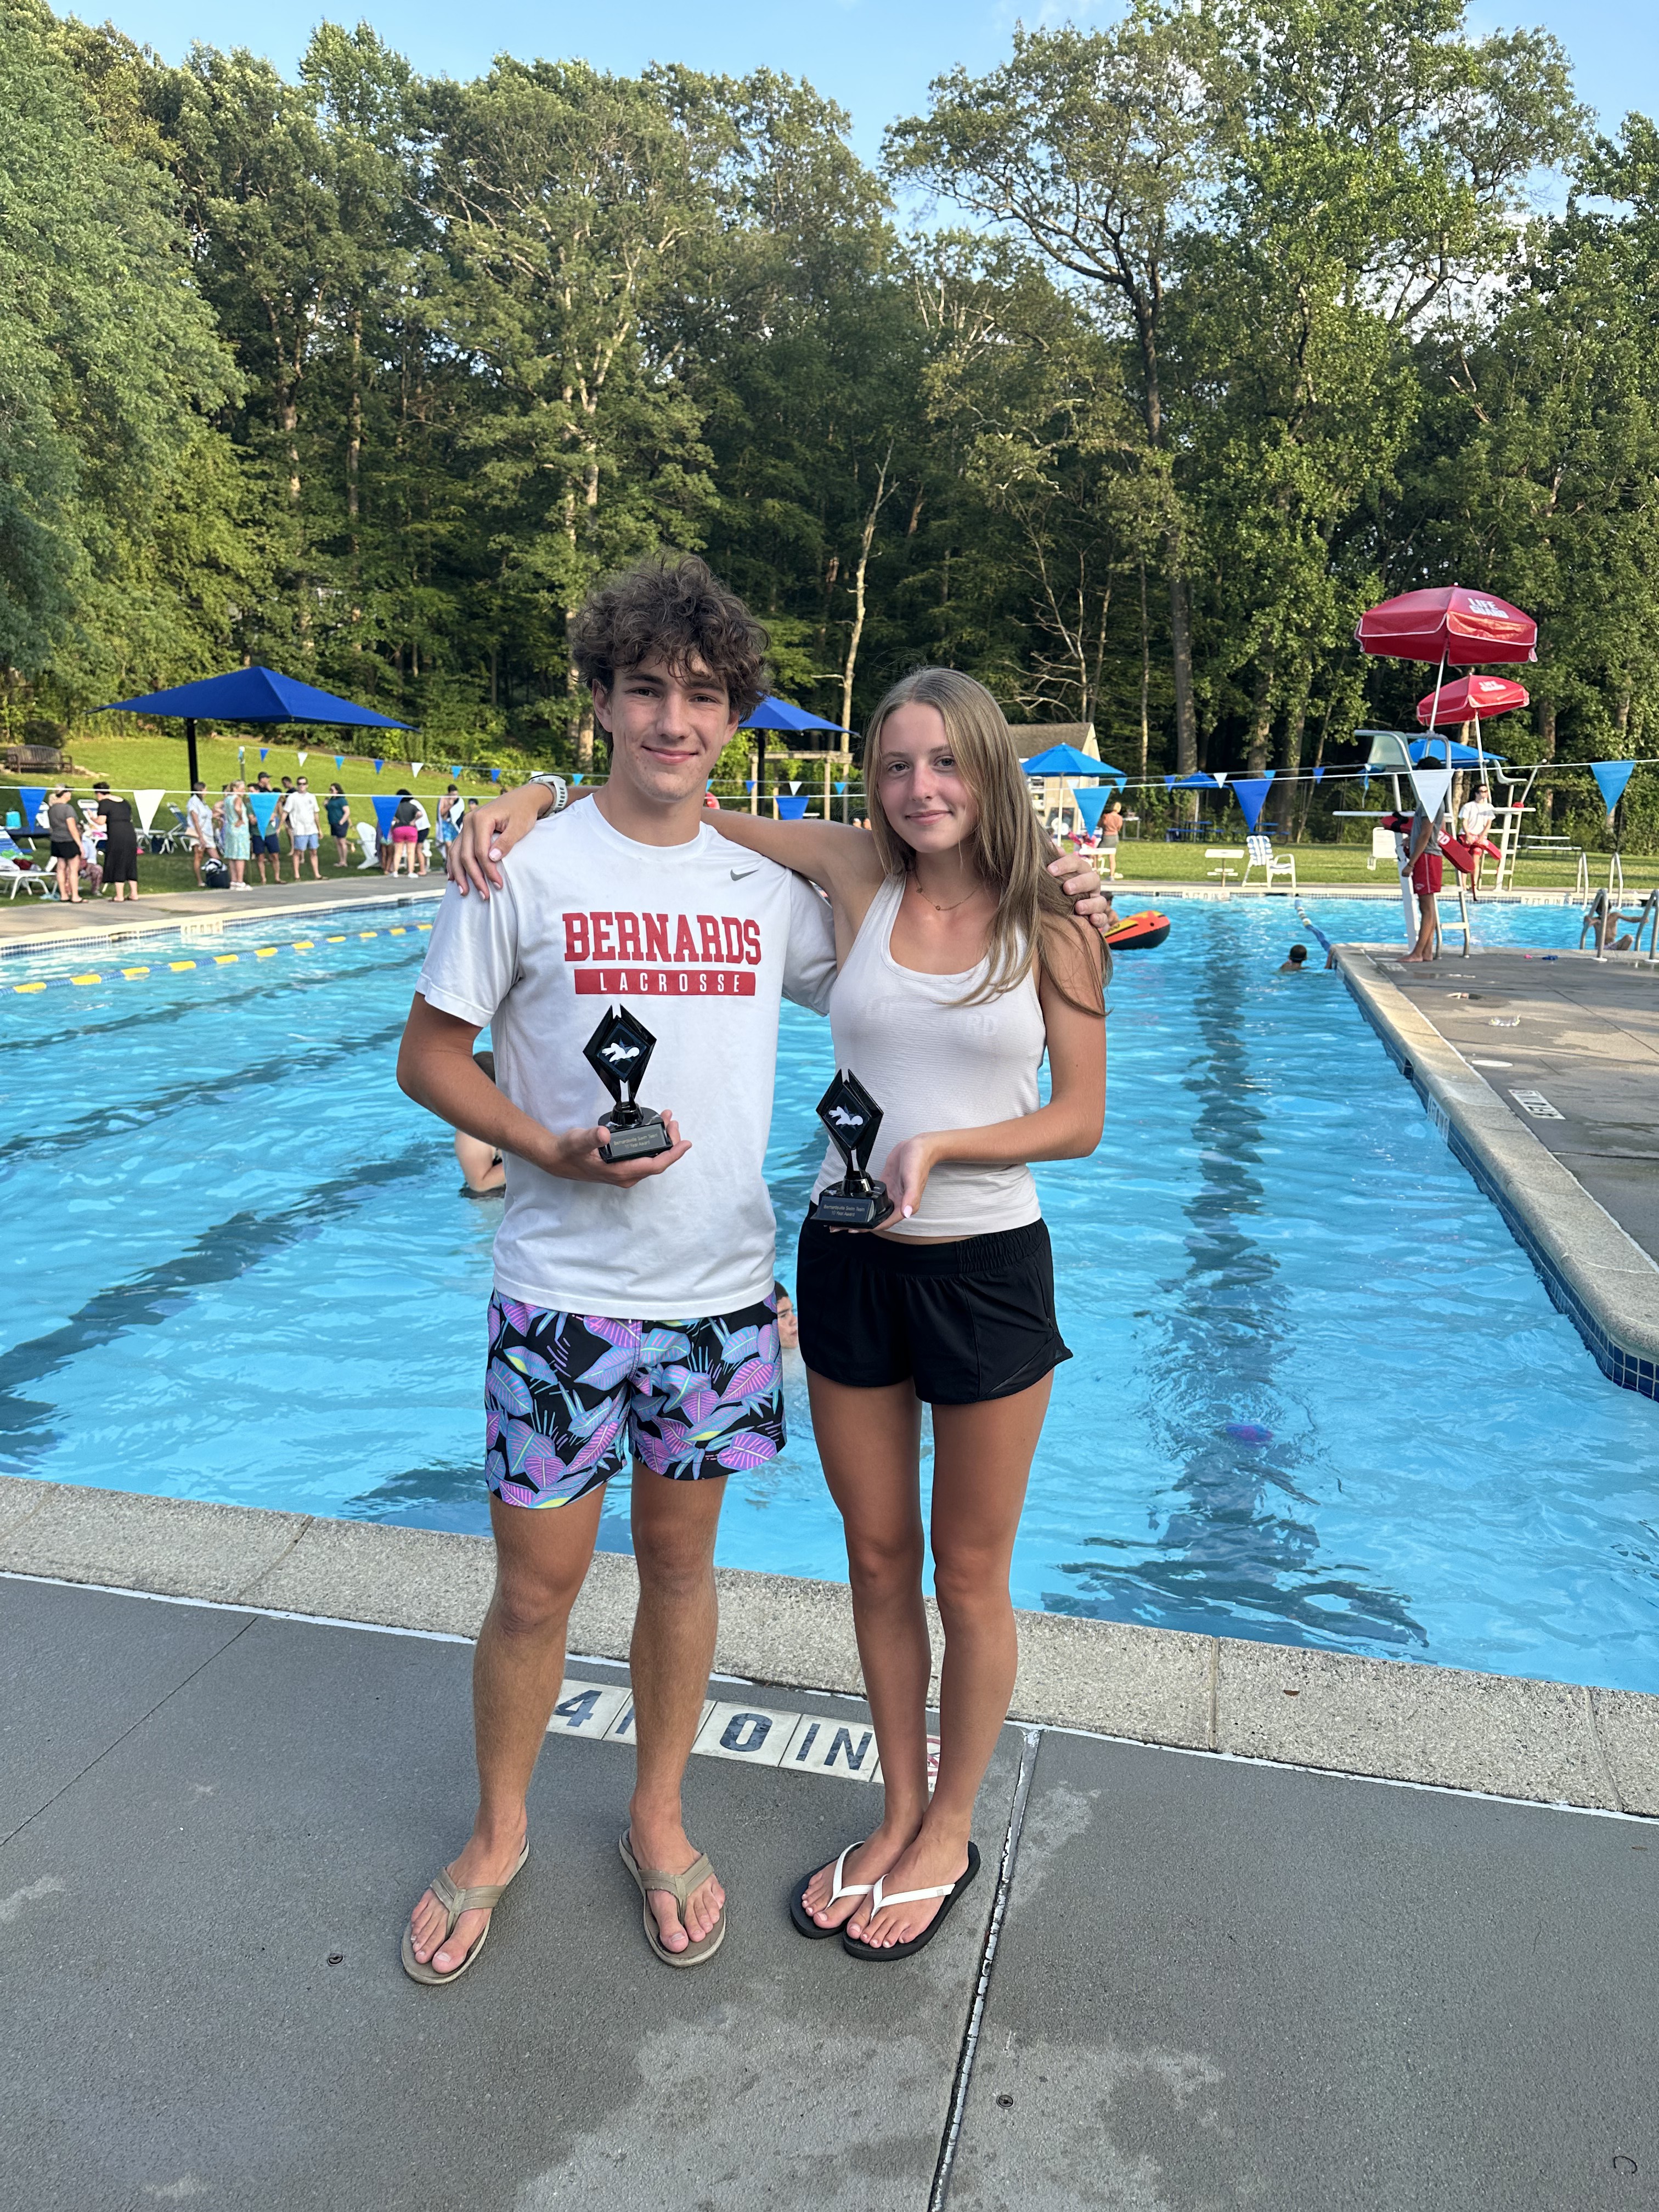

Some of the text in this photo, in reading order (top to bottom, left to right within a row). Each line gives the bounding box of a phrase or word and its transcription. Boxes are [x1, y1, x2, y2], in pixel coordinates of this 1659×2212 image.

[1468, 597, 1498, 610] LIFE
[562, 912, 761, 965] BERNARDS
[600, 972, 740, 992] LACROSSE
[552, 1690, 602, 1728] 4
[795, 1723, 873, 1770] IN
